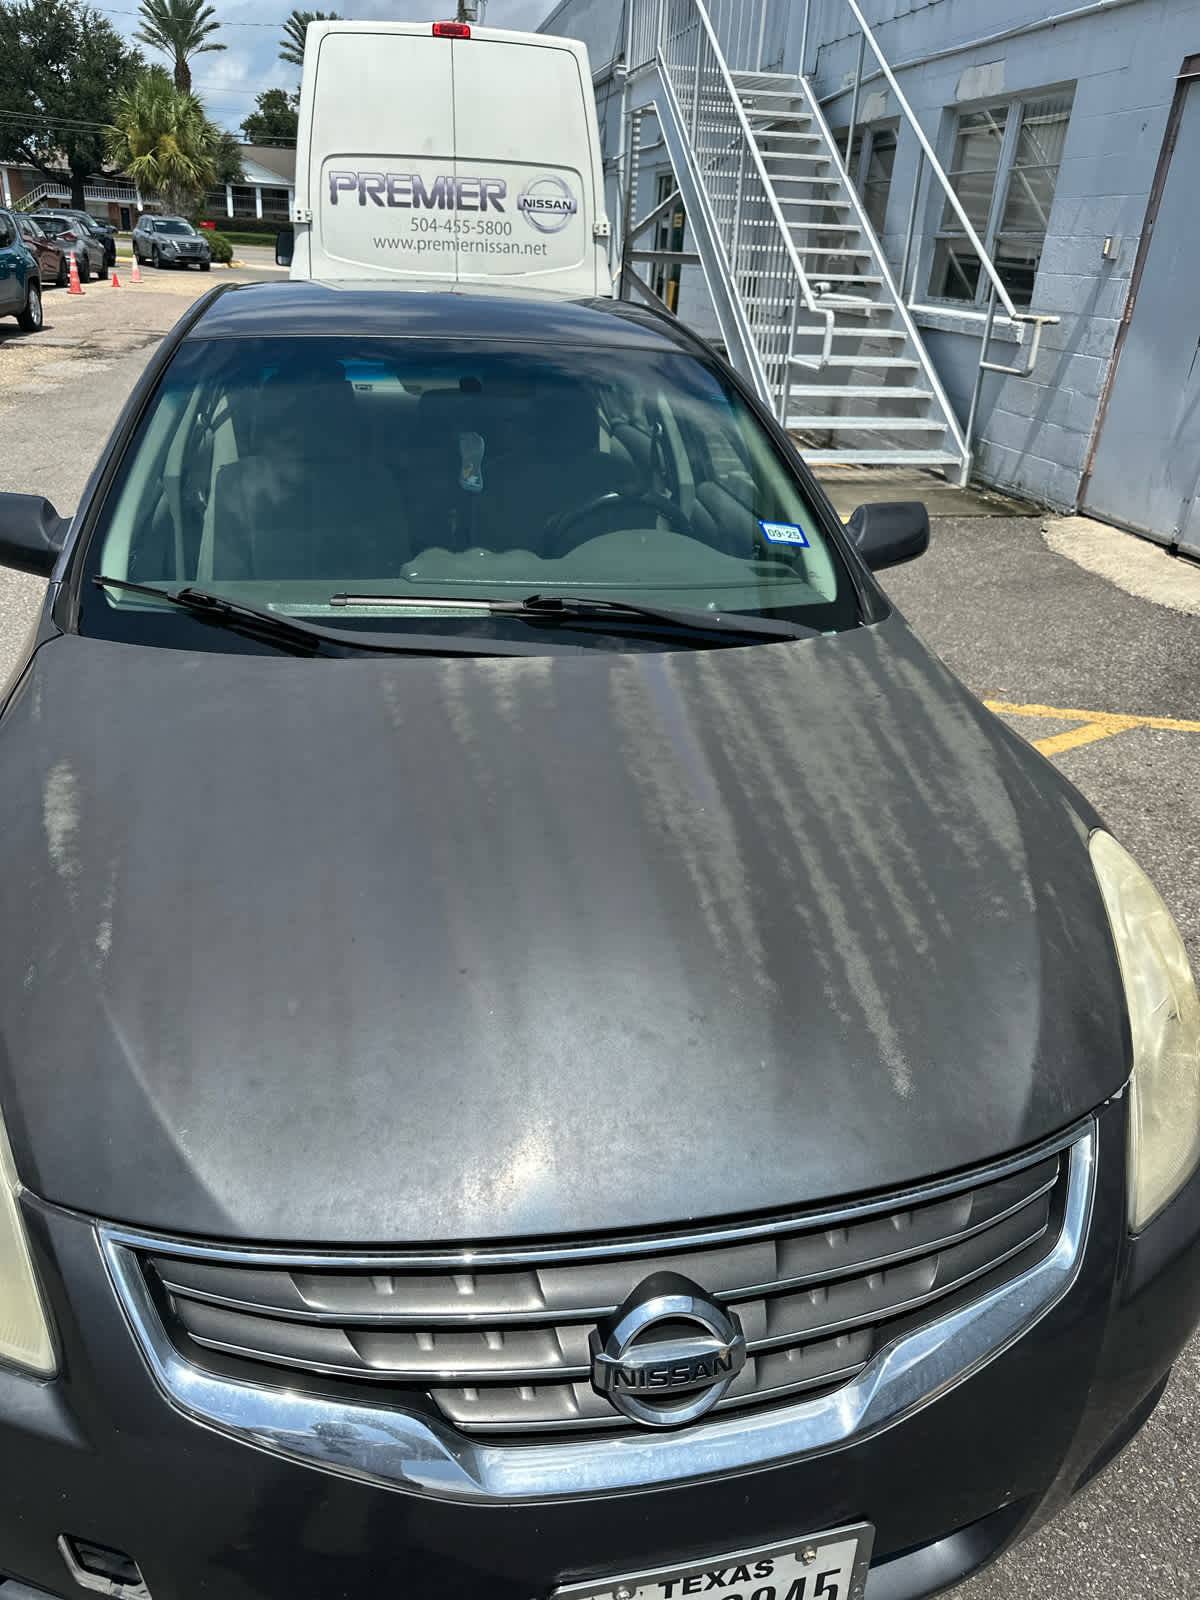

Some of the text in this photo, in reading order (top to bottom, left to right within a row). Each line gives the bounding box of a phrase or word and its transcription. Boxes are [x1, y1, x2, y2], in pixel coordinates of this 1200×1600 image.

[329, 171, 506, 212] PREMIER
[523, 198, 572, 210] NISSAN
[410, 217, 512, 236] 504-455-5800
[373, 237, 547, 256] www.premiernissan.net
[613, 1353, 733, 1389] NISSAN
[658, 1560, 775, 1599] TEXAS
